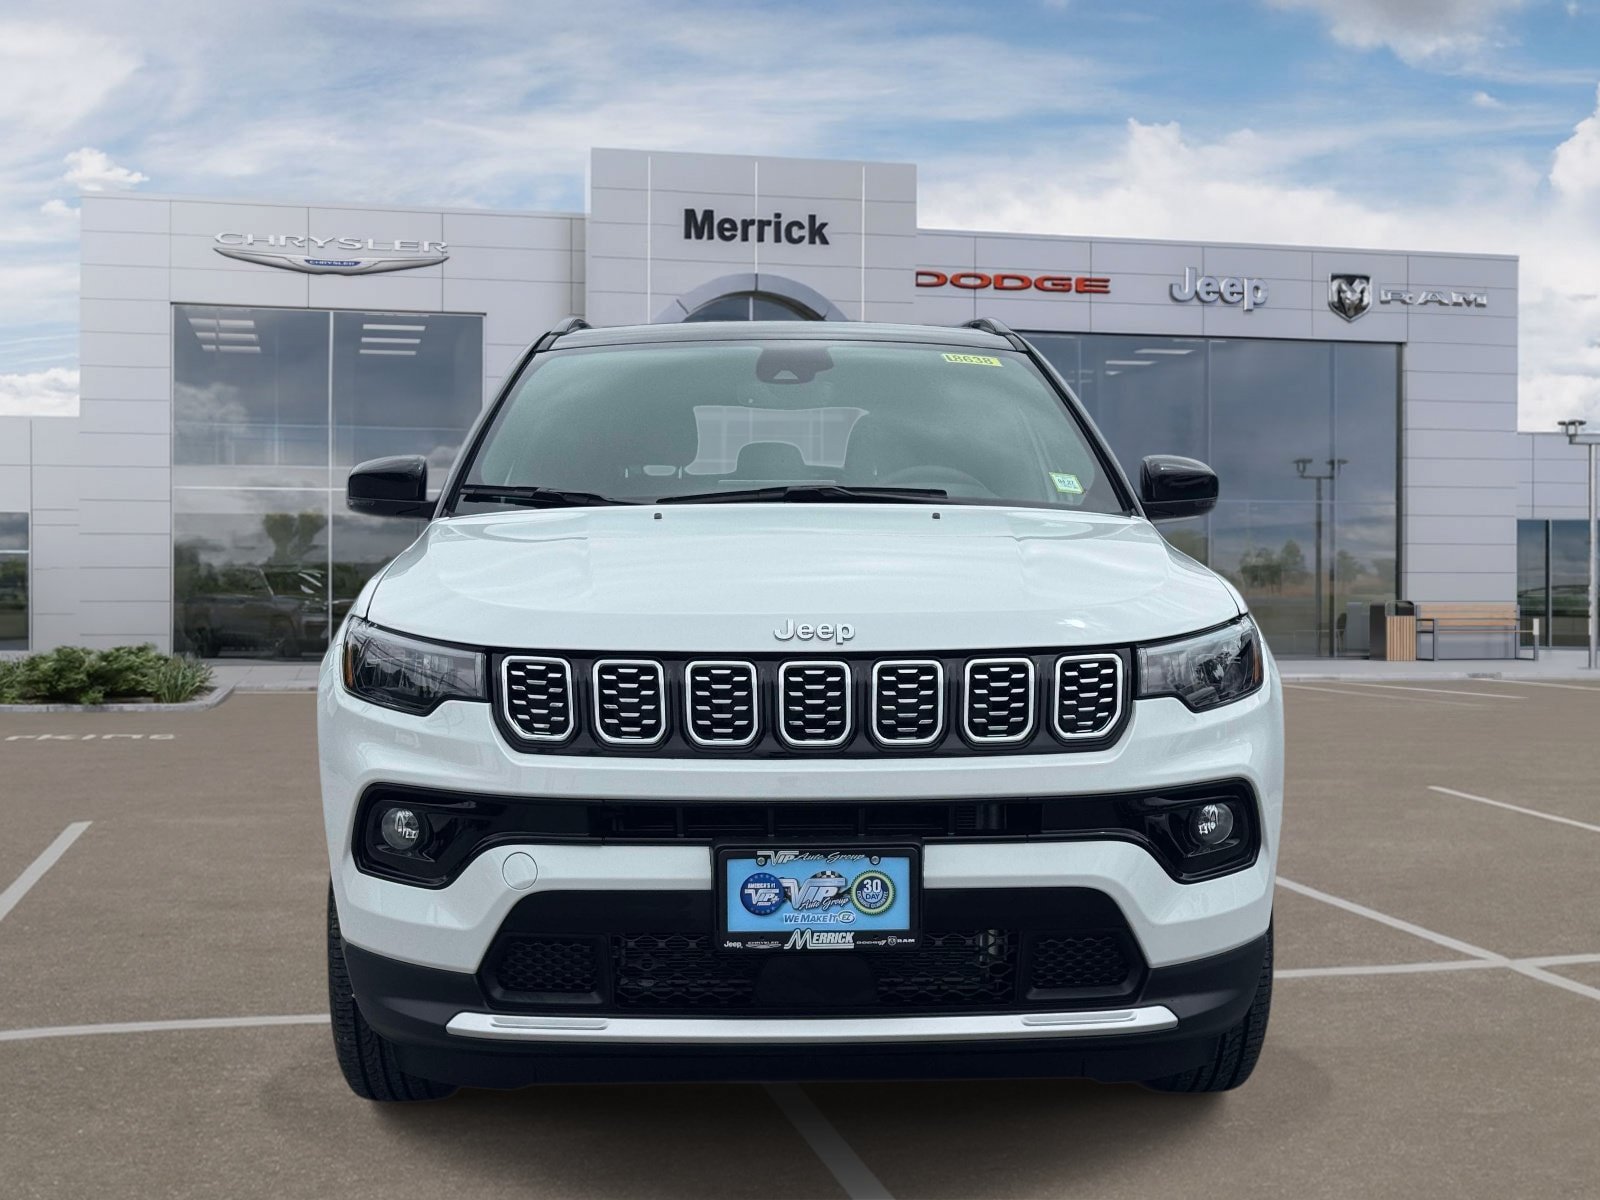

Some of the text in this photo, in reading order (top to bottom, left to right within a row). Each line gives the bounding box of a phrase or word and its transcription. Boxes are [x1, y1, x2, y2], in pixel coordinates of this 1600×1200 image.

[684, 208, 829, 245] Merrick
[214, 232, 449, 254] CHRYSLER
[915, 271, 1111, 294] DODGE
[1169, 266, 1269, 312] Jeep
[1379, 288, 1487, 308] RAM
[774, 618, 855, 645] Jeep
[757, 850, 865, 866] VIP Auto Group
[779, 878, 845, 909] VIP
[863, 879, 882, 893] 30
[799, 899, 820, 911] Auto
[822, 896, 850, 911] Group
[724, 940, 742, 949] Jeep
[783, 927, 854, 950] MERRICK
